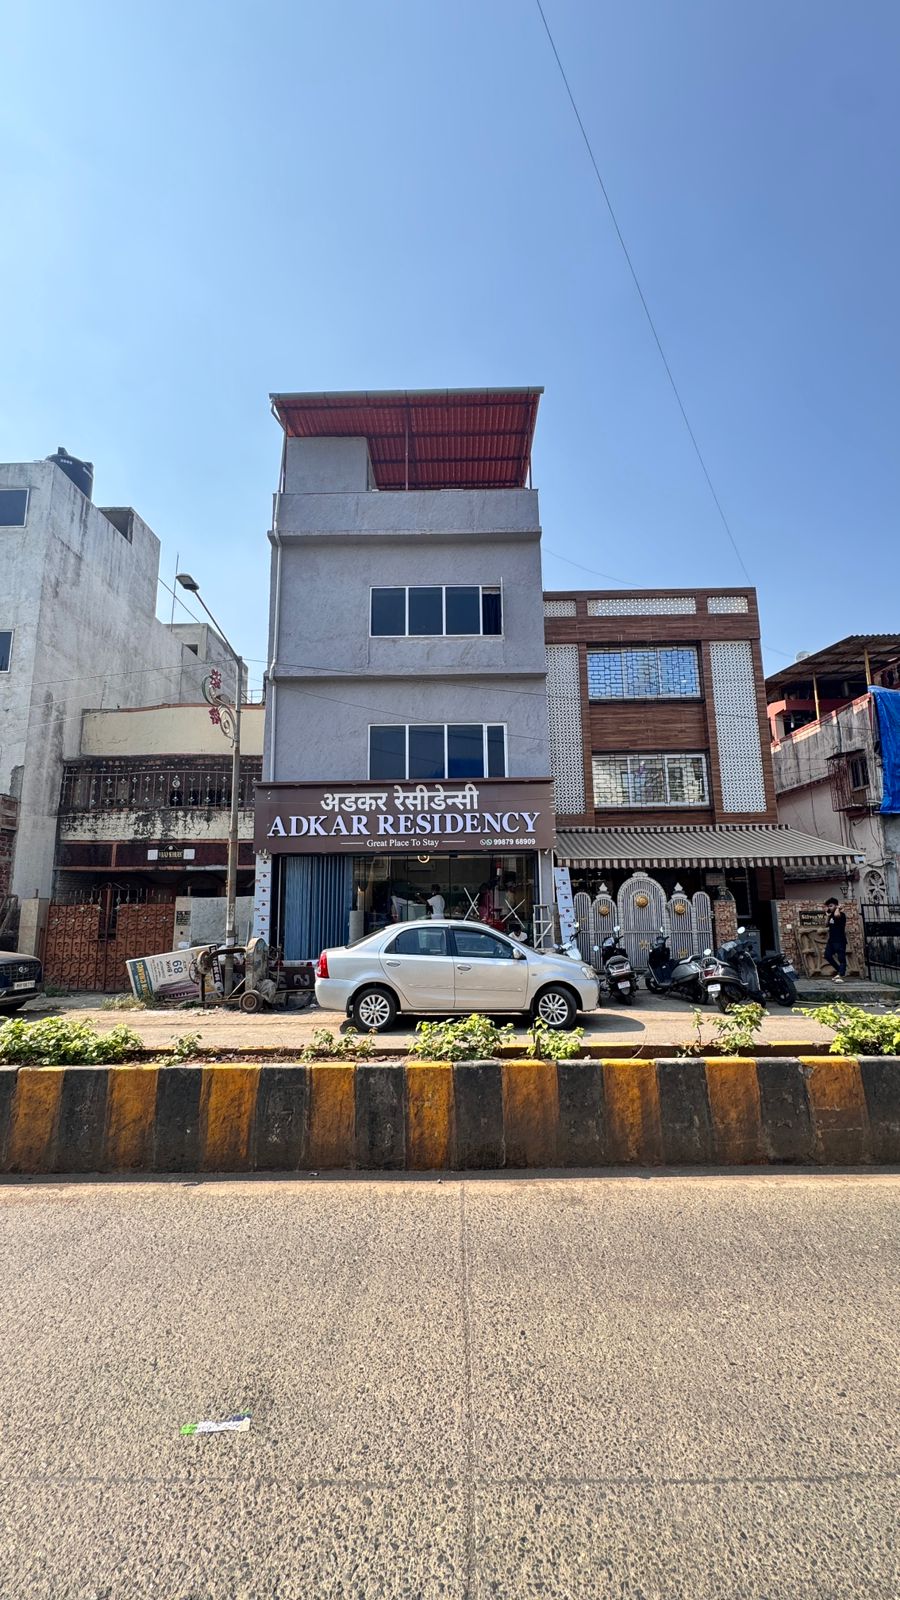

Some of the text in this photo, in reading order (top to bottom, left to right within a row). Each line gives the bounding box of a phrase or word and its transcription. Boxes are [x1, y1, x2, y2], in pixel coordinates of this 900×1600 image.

[320, 783, 479, 812] अडकर रेसीडेन्सी
[267, 811, 540, 837] ADKAR RESIDENCY
[366, 838, 440, 848] Great Place To Stay
[493, 838, 514, 846] 99879
[172, 960, 183, 974] 89
